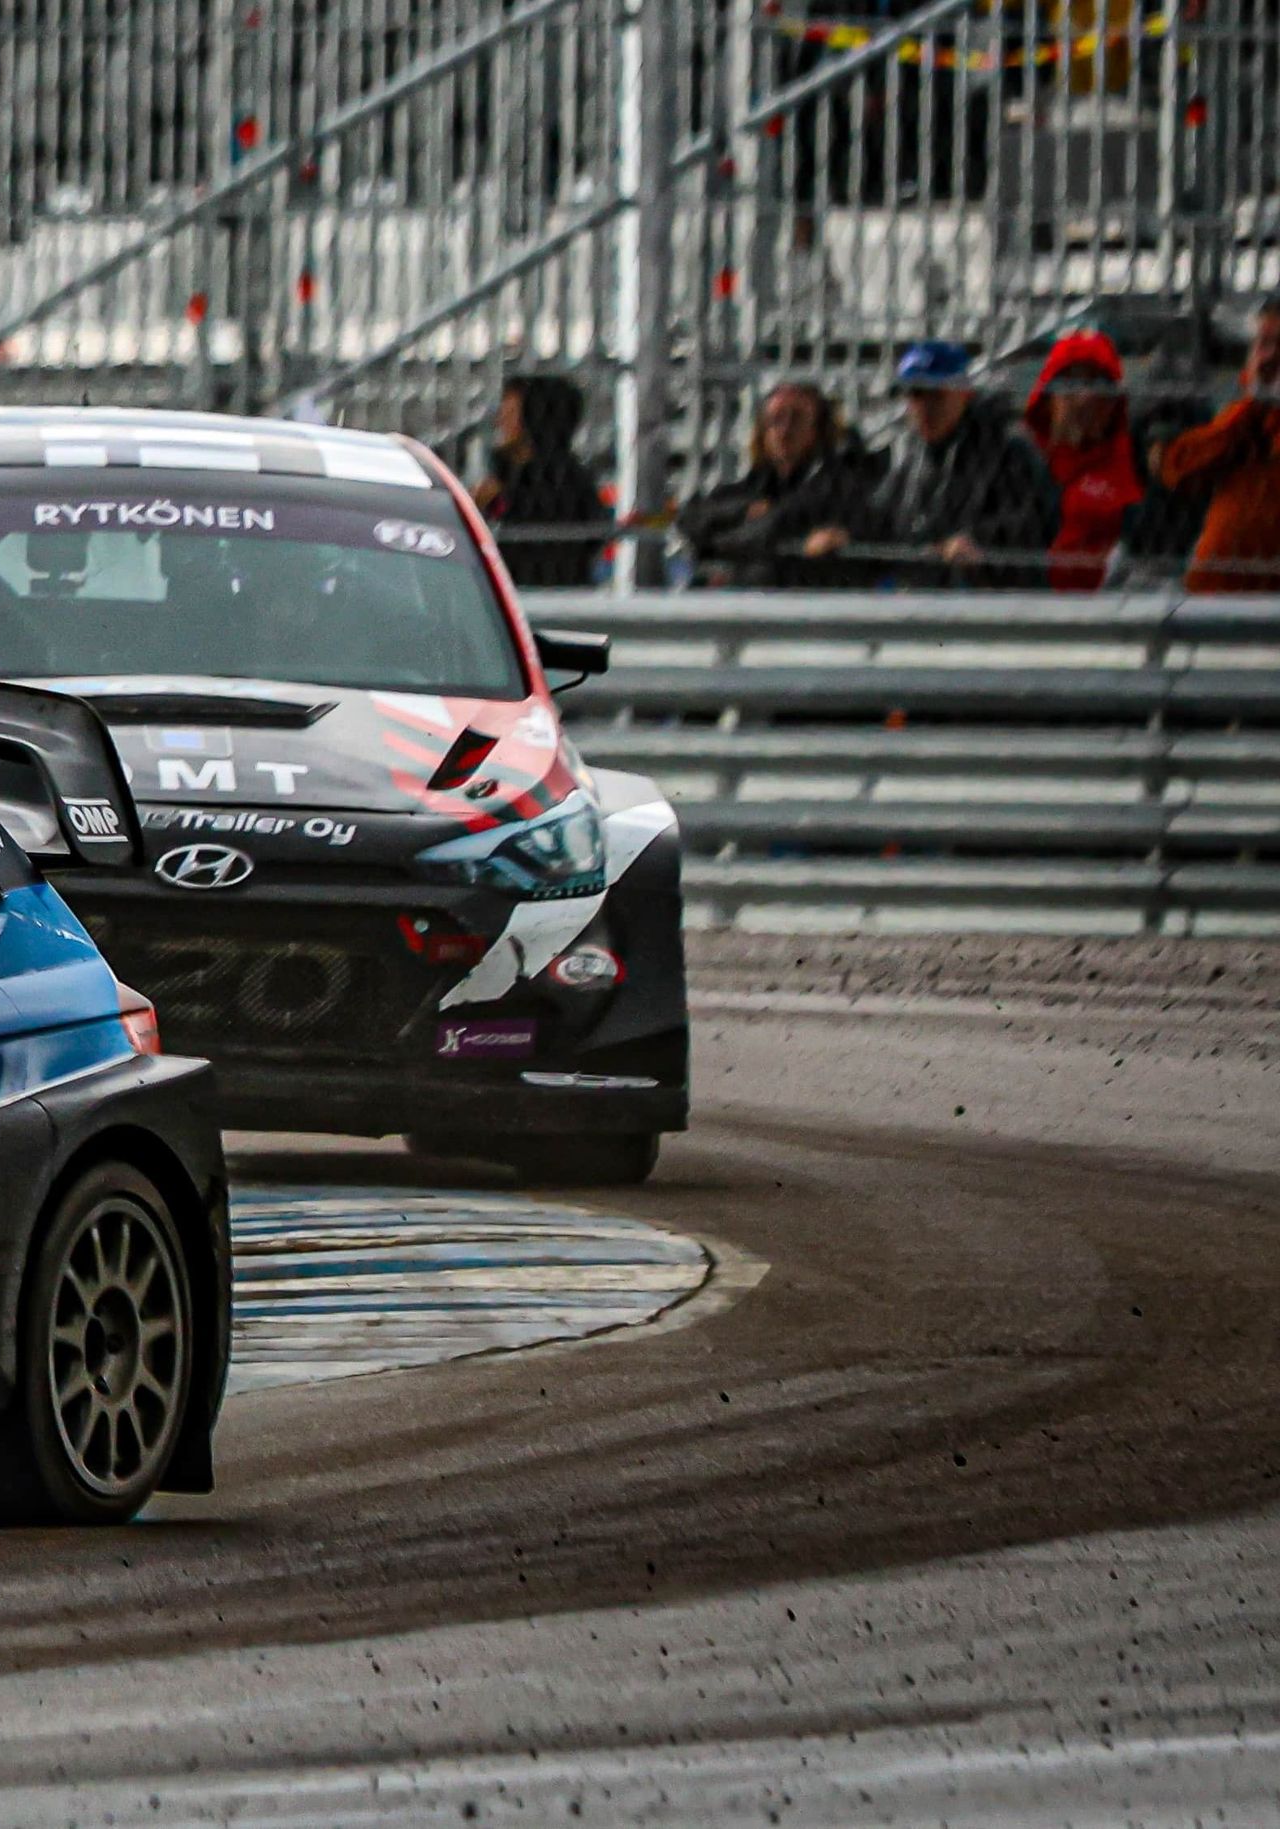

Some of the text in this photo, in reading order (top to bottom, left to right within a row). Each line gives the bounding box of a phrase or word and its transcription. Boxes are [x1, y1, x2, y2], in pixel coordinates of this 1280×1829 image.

[33, 499, 276, 531] RYTKÖNEN
[67, 805, 121, 834] OMP
[303, 816, 358, 846] Oy
